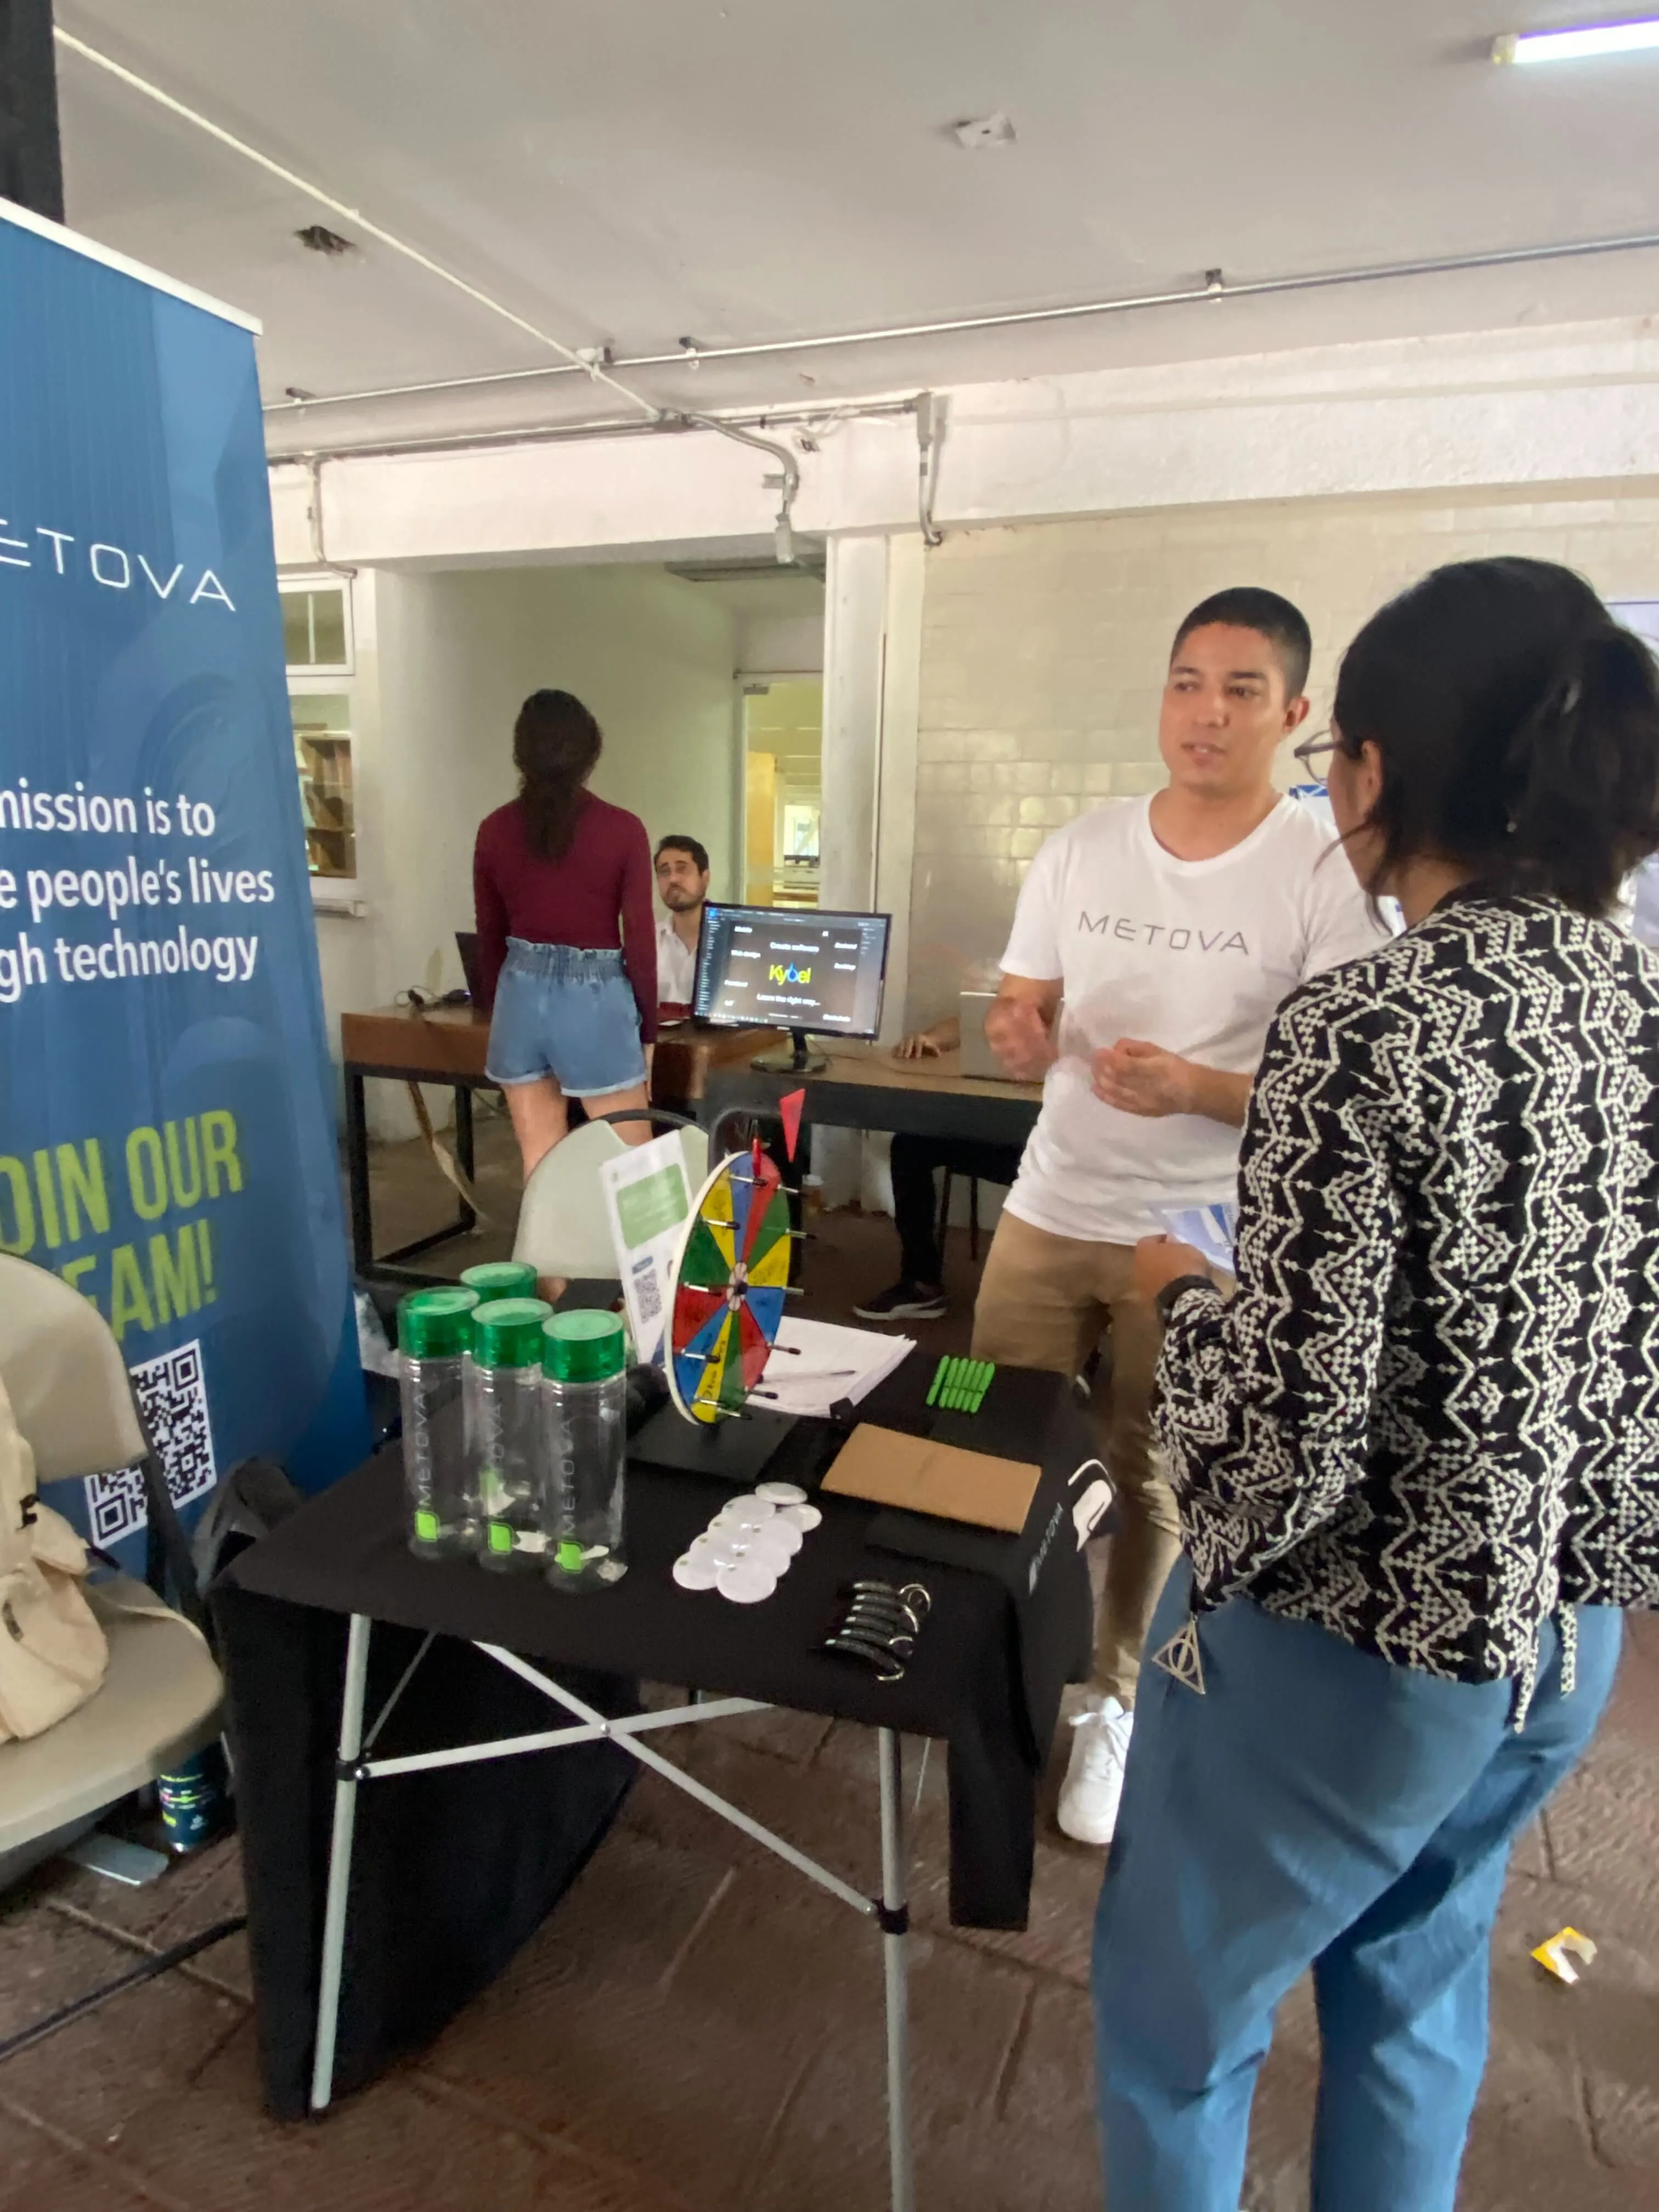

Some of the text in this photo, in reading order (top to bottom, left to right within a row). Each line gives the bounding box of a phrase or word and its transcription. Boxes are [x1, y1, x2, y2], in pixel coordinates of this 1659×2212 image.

[0, 518, 236, 612] ETOVA
[144, 786, 170, 836] is
[177, 795, 215, 837] to
[0, 856, 274, 923] e people's lives
[1078, 910, 1249, 955] METOVA
[0, 925, 258, 1003] gh technology
[0, 1110, 244, 1256] OIN OUR
[62, 1218, 217, 1342] AM!
[412, 1393, 432, 1507] METOVA
